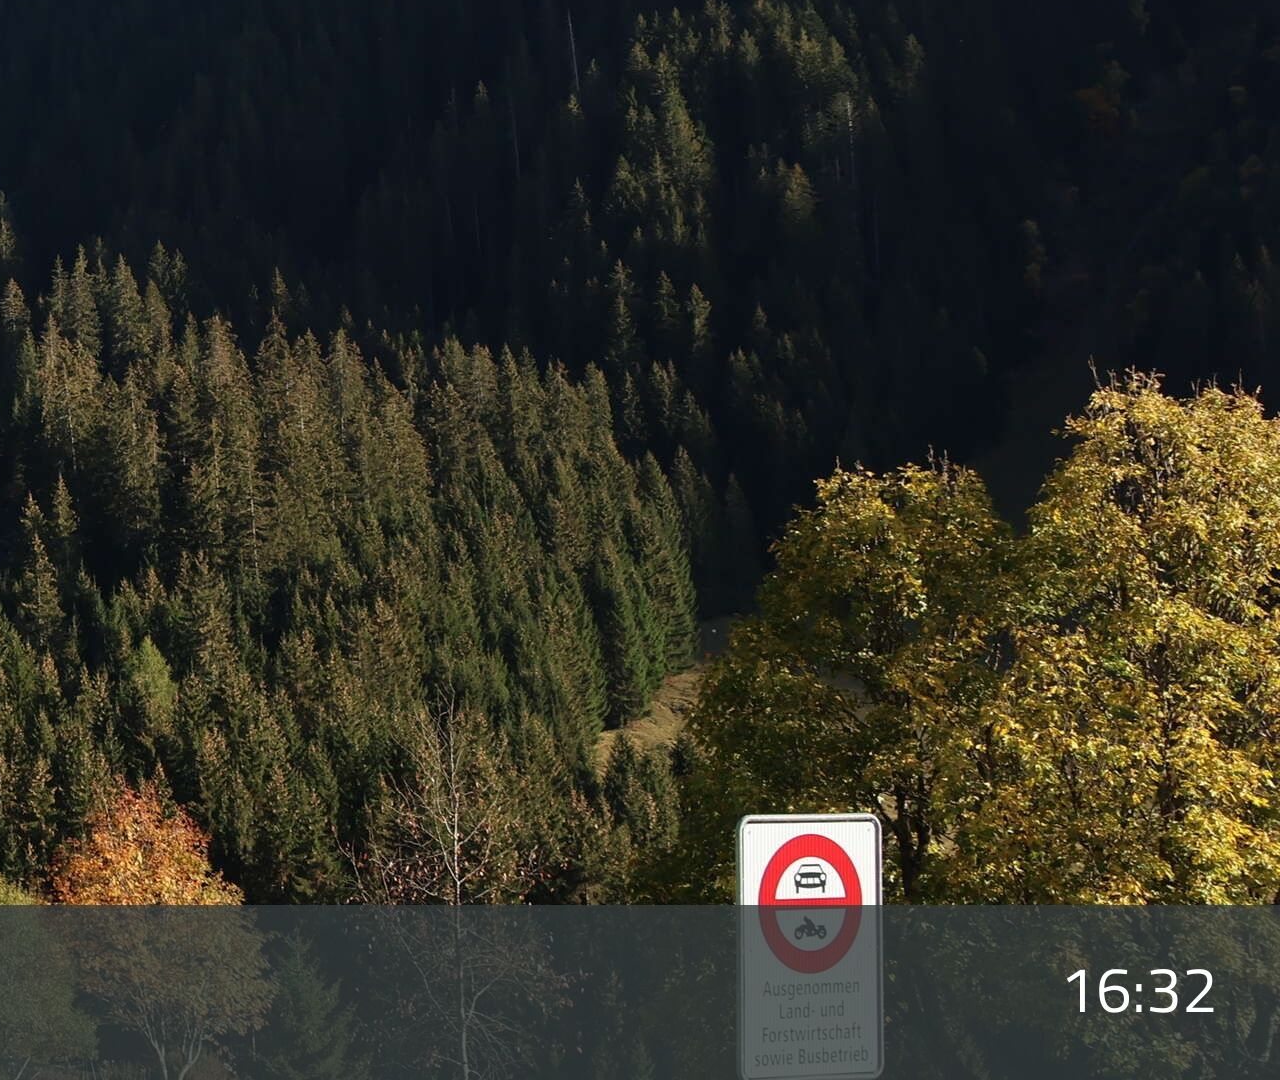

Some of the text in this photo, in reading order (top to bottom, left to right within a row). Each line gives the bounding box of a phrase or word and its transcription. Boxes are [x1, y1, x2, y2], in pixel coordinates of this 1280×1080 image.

[762, 980, 860, 1000] Ausgenommen
[779, 1000, 845, 1019] Land- und
[762, 1022, 862, 1043] Forstwirtschaft
[754, 1045, 869, 1067] sowie Busbetrieb
